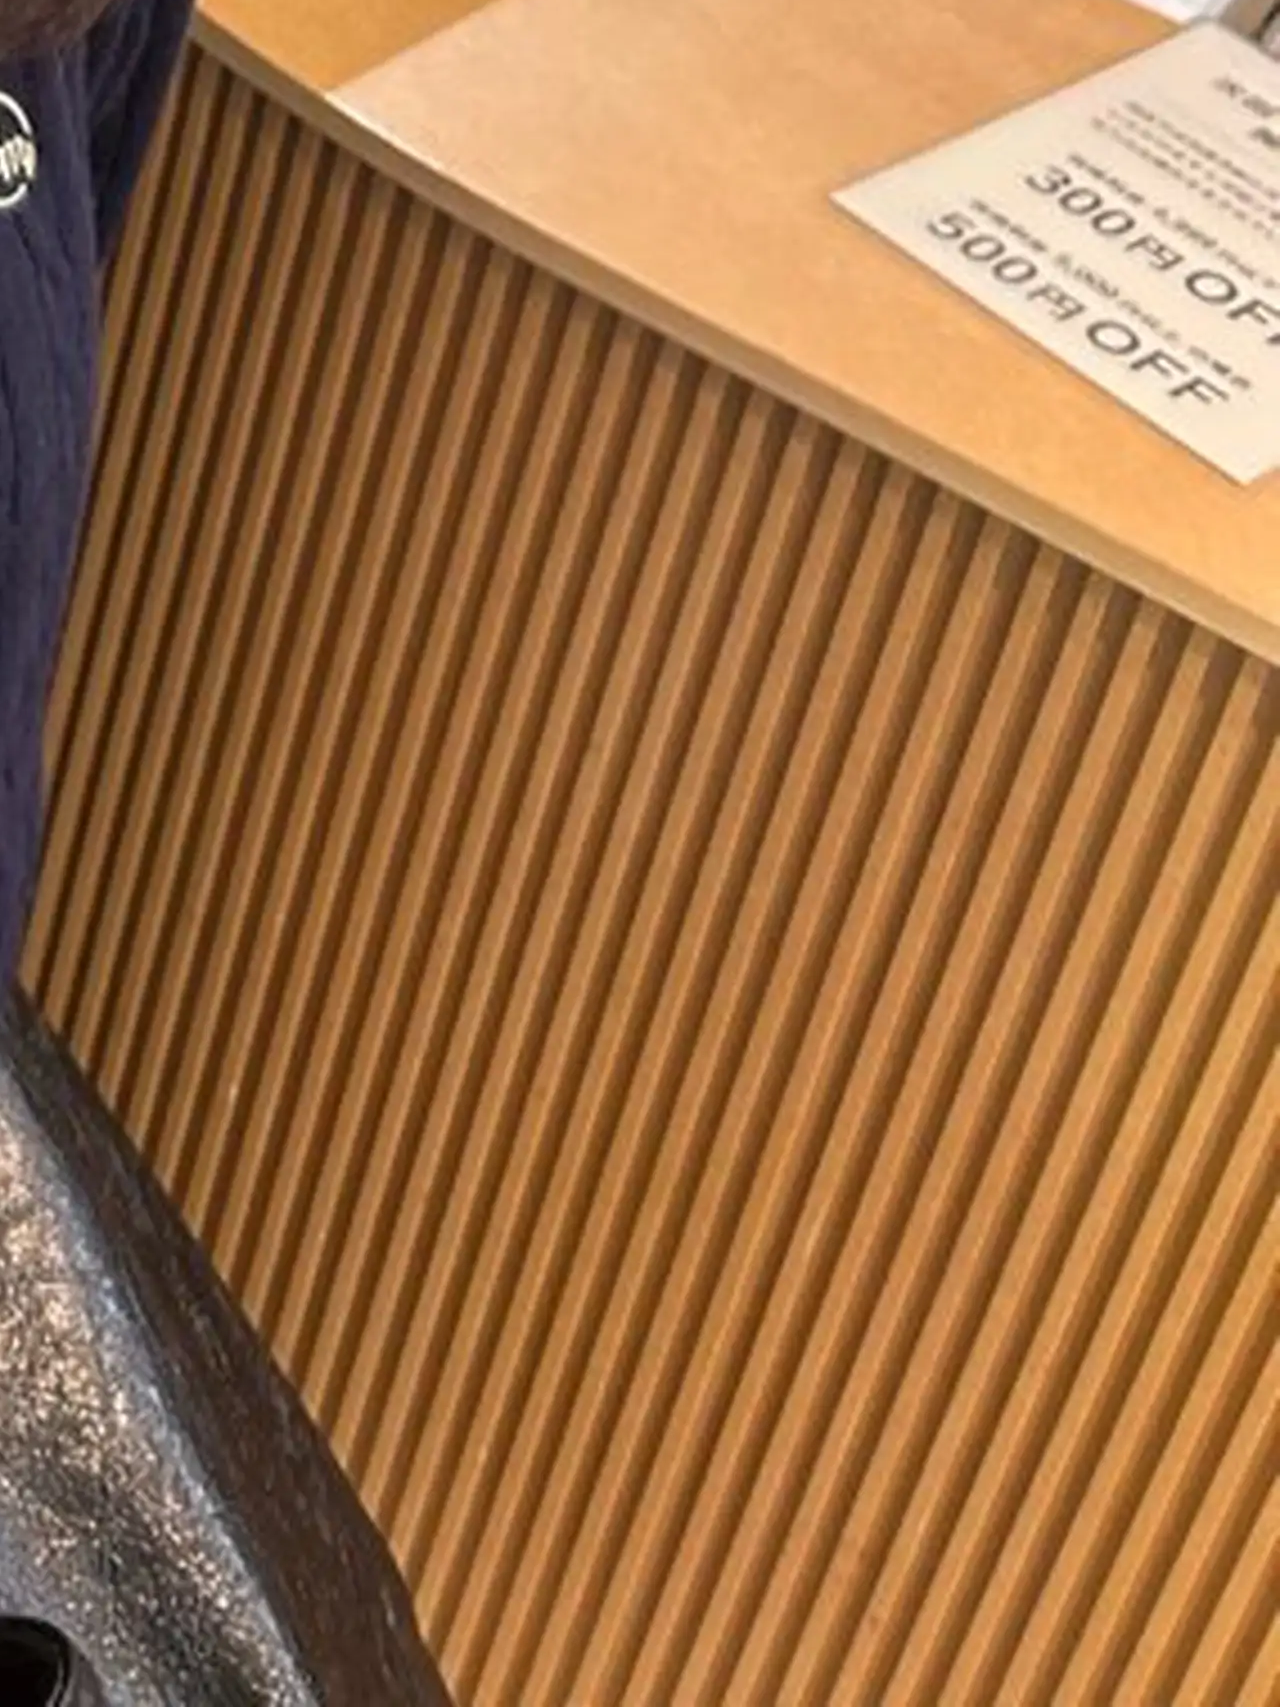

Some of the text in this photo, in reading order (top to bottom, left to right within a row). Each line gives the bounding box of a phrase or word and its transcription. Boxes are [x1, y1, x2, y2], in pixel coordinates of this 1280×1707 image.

[926, 210, 1087, 322] 500円
[1085, 319, 1231, 406] OFF
[1184, 268, 1280, 346] OF
